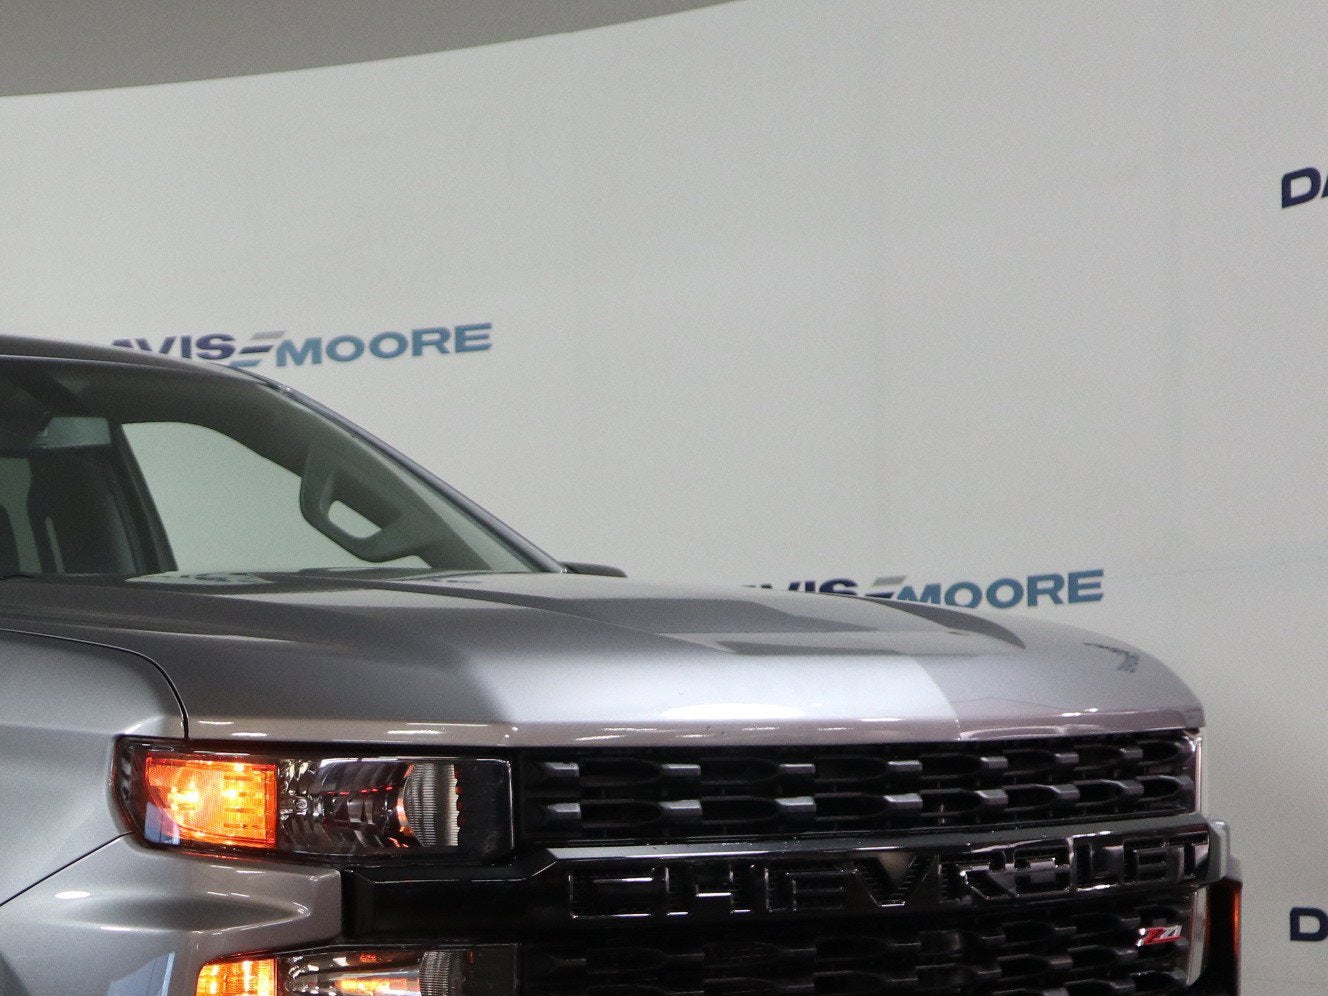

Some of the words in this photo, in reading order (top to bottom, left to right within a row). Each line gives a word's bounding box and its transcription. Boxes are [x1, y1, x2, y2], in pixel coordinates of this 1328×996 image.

[1281, 167, 1328, 210] D
[276, 322, 492, 367] MOORE
[897, 569, 1104, 609] MOORE
[568, 833, 1210, 918] CHEVROLET
